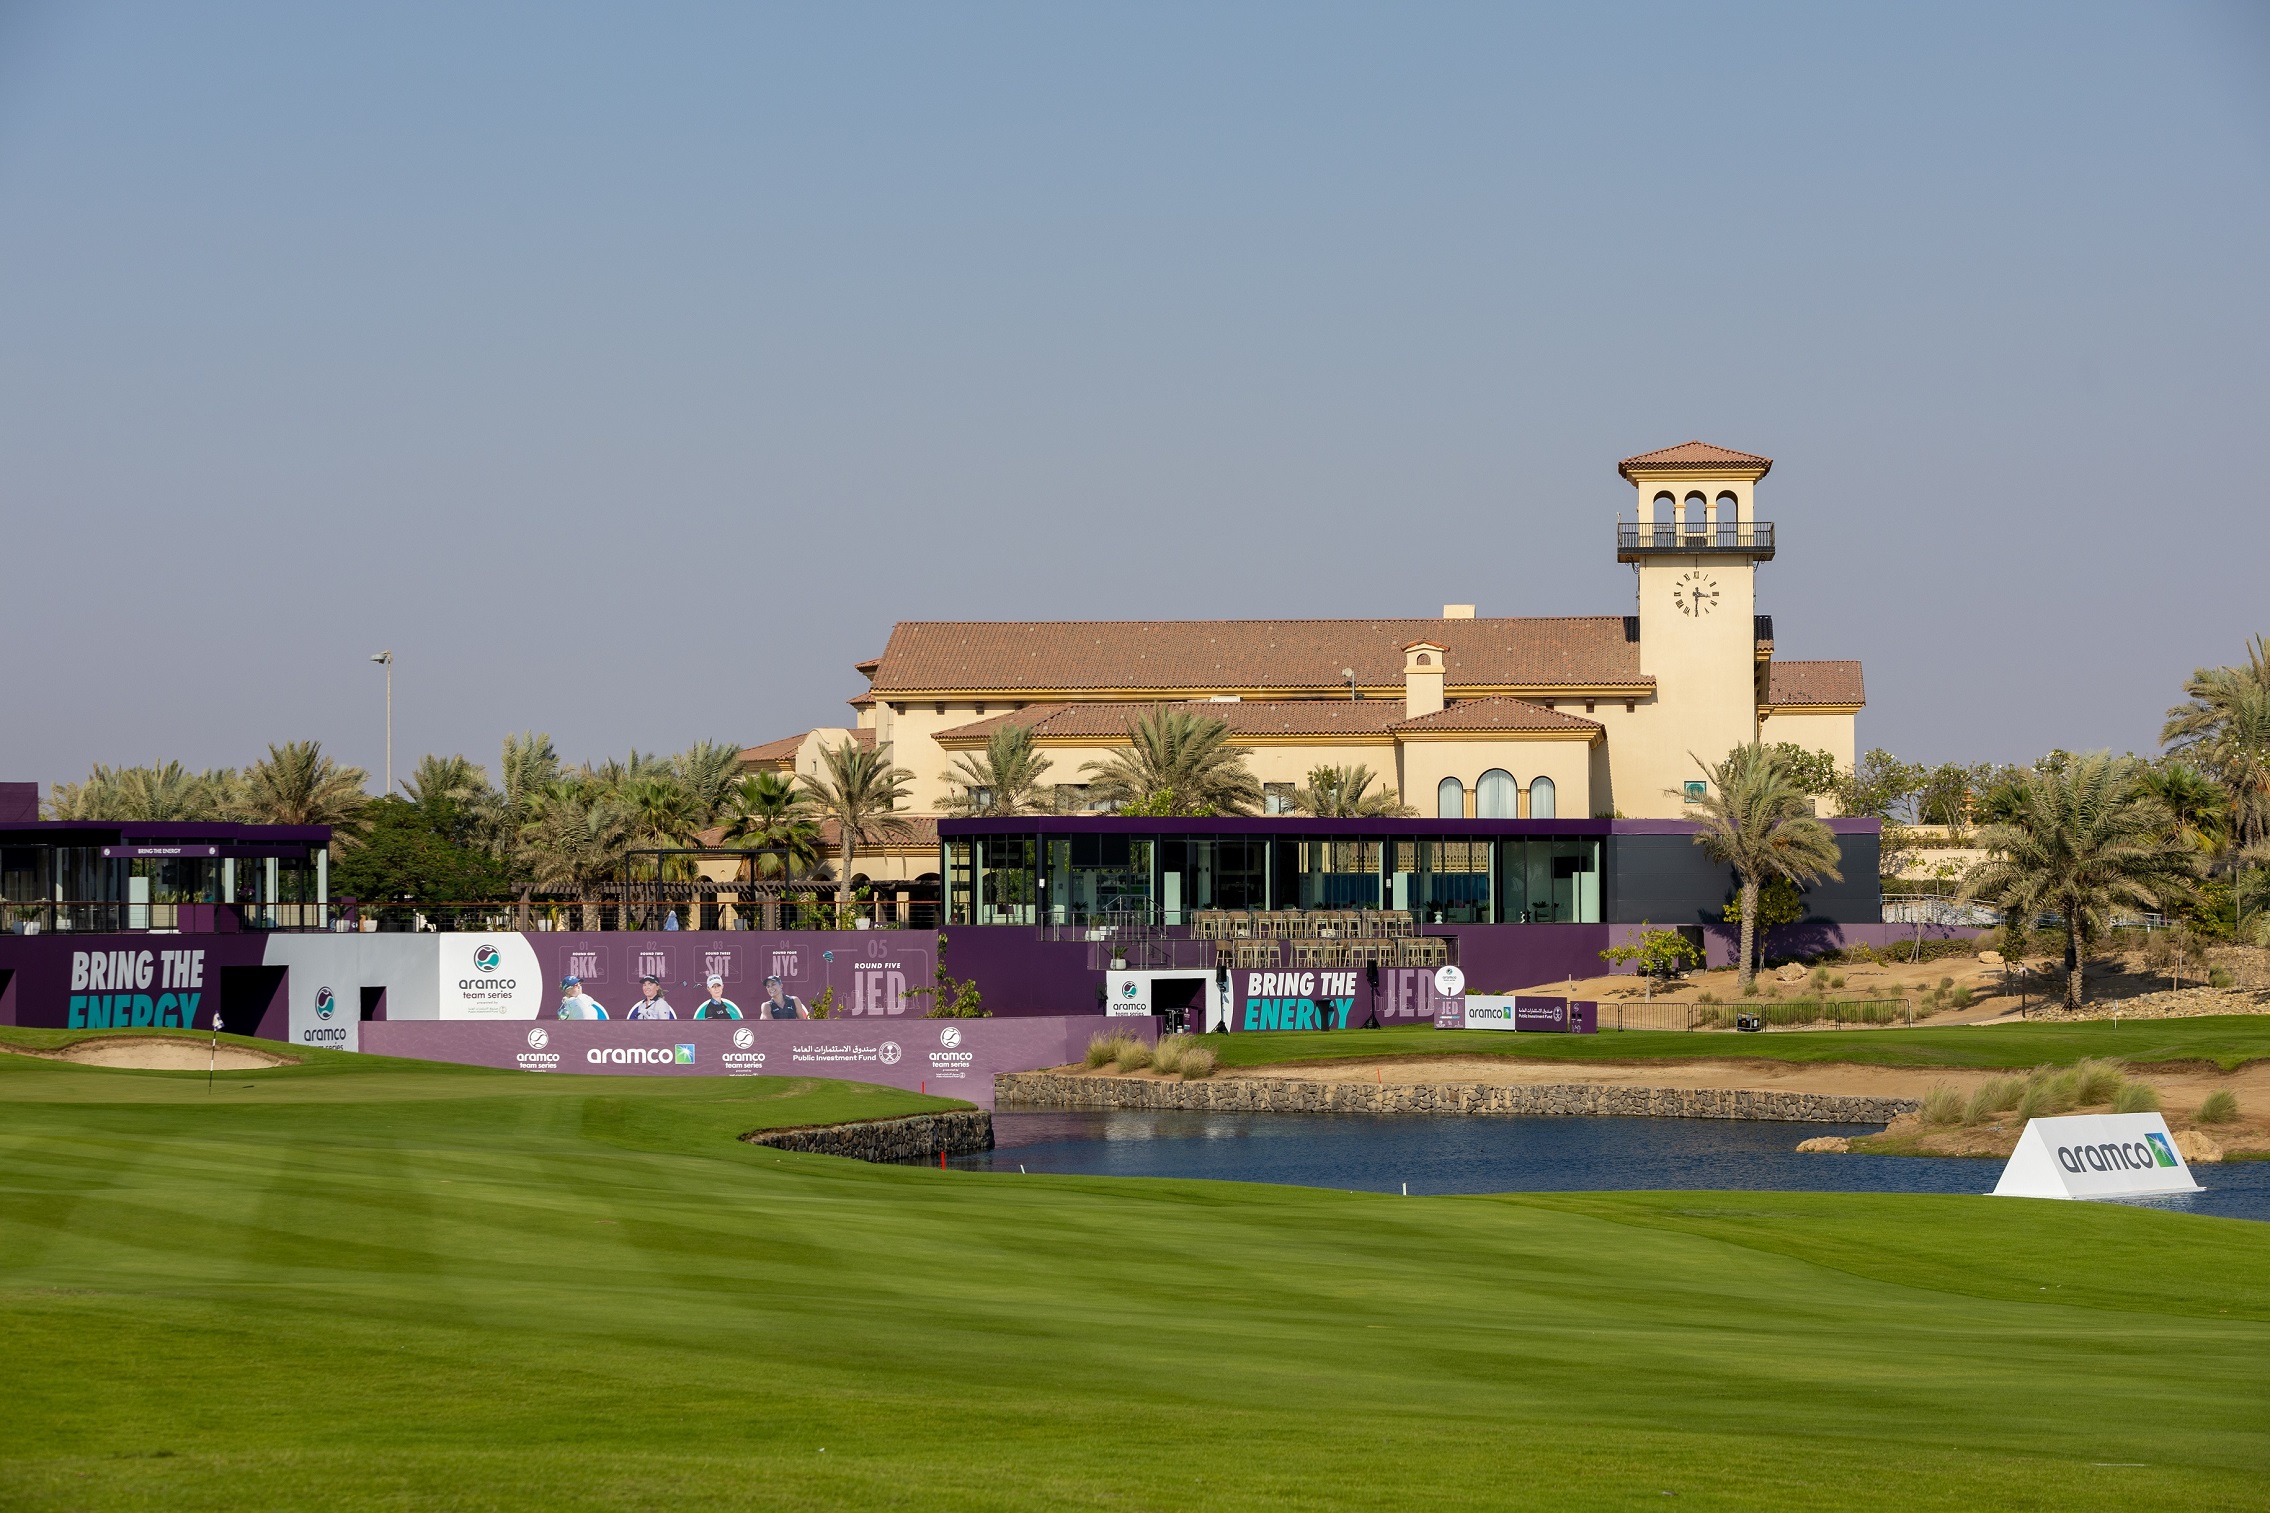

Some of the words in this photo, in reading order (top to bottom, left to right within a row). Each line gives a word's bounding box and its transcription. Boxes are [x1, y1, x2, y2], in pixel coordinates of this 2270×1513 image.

[580, 942, 588, 950] 01
[647, 941, 657, 950] 02
[713, 941, 723, 950] 03
[780, 940, 790, 949] 04
[868, 940, 888, 958] 05
[70, 950, 154, 990] BRING
[161, 950, 205, 989] THE
[570, 956, 597, 978] BKK
[639, 956, 666, 978] LDN
[706, 956, 731, 977] SOT
[773, 955, 798, 976] NYC
[459, 979, 516, 989] aramco
[1247, 972, 1315, 996] BRING
[1321, 972, 1357, 996] THE
[488, 990, 512, 999] series
[852, 971, 906, 1016] JED
[1384, 969, 1434, 1017] JED
[68, 992, 201, 1030] ENERGY
[1442, 1001, 1458, 1014] JED
[1469, 1009, 1502, 1018] aramco
[304, 1028, 346, 1041] aramco
[587, 1049, 673, 1063] aramco
[814, 1046, 851, 1054] الاستثمارات
[929, 1052, 972, 1060] aramco
[2058, 1142, 2153, 1173] aramco
